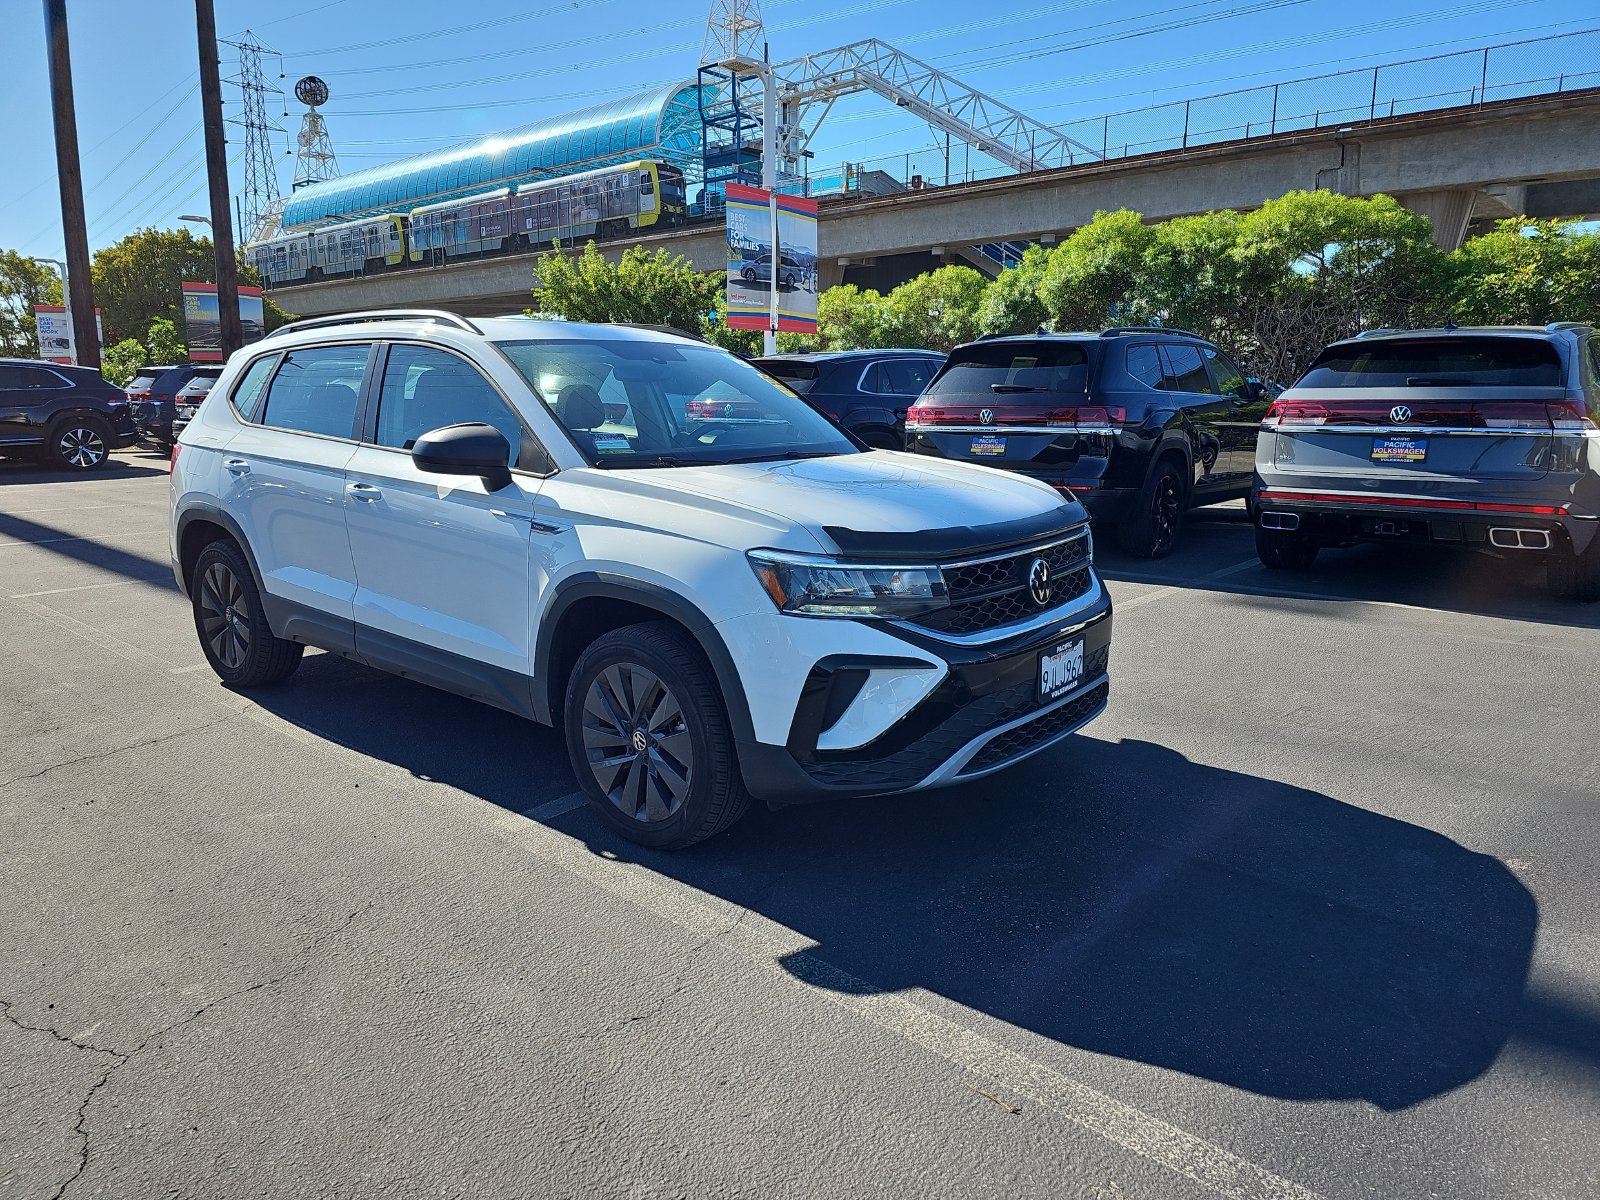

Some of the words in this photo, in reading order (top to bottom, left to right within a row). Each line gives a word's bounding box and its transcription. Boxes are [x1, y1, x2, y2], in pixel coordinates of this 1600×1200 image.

[730, 212, 746, 223] BEST
[730, 221, 748, 232] CARS
[730, 229, 745, 241] FOR
[730, 238, 760, 251] FAMILIES
[1373, 447, 1426, 455] VOLKSWAGEN
[1384, 441, 1416, 449] PACIFIC
[1056, 641, 1073, 653] PACIFIC
[1042, 655, 1083, 694] 9JLJ962
[1051, 680, 1078, 698] VOLKSWAGEN
